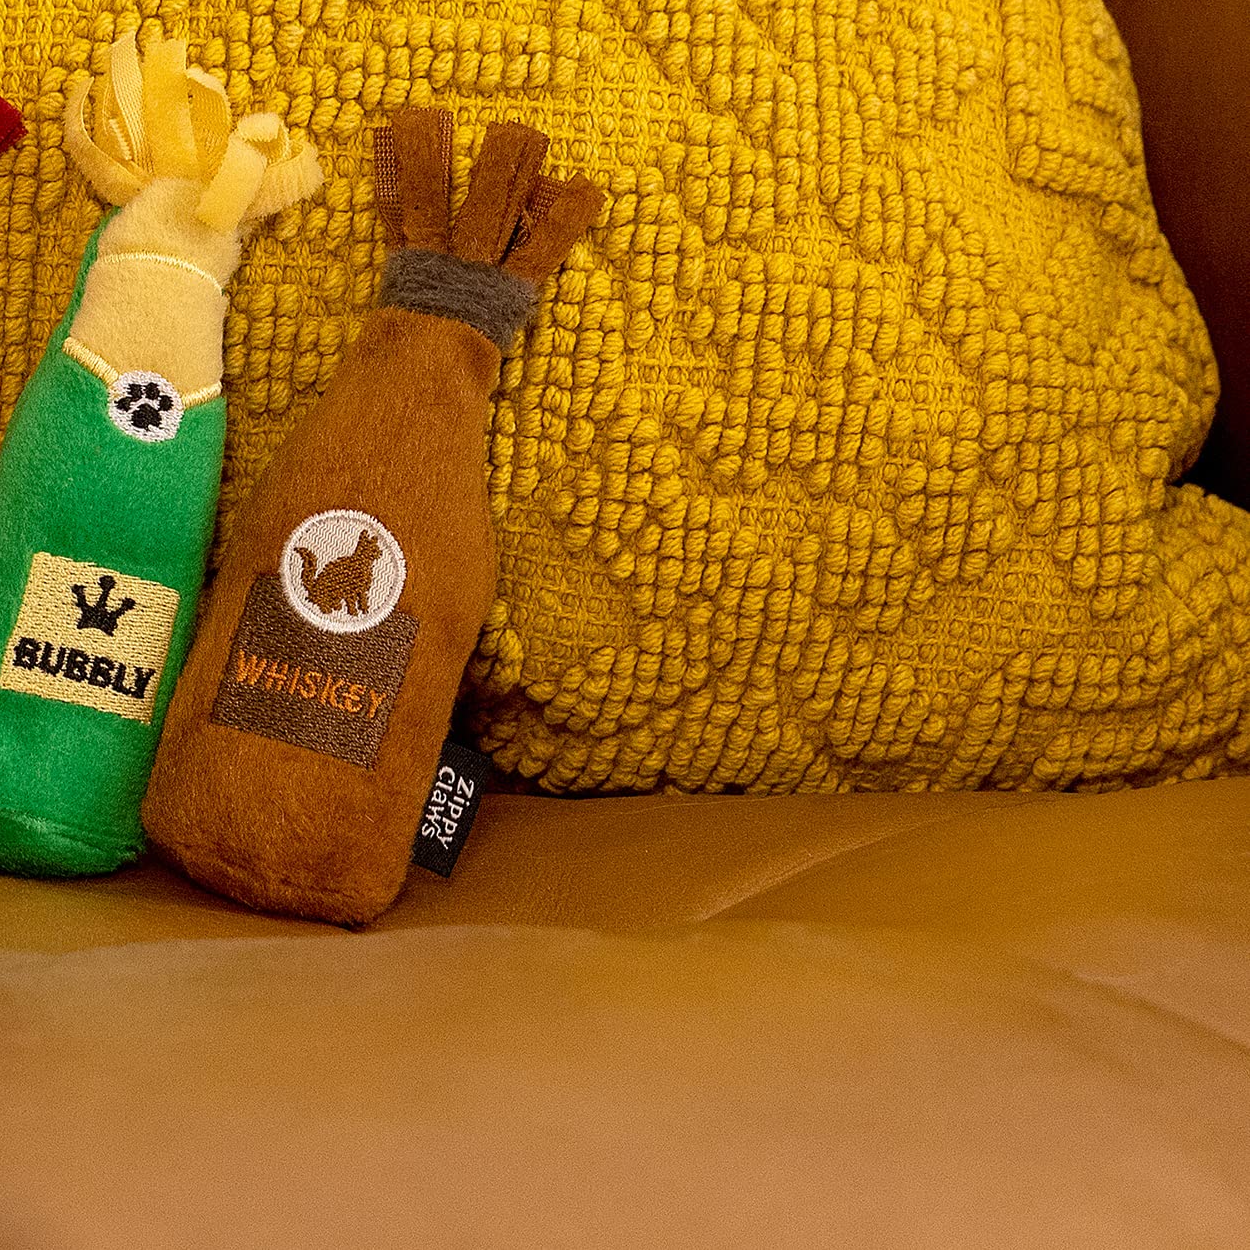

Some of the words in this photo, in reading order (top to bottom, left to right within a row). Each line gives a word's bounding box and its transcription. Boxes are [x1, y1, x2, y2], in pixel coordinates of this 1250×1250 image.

[13, 636, 156, 699] BUBBLY
[236, 650, 386, 718] WHISKEY
[421, 766, 456, 839] Claws
[435, 776, 474, 850] Zippy
